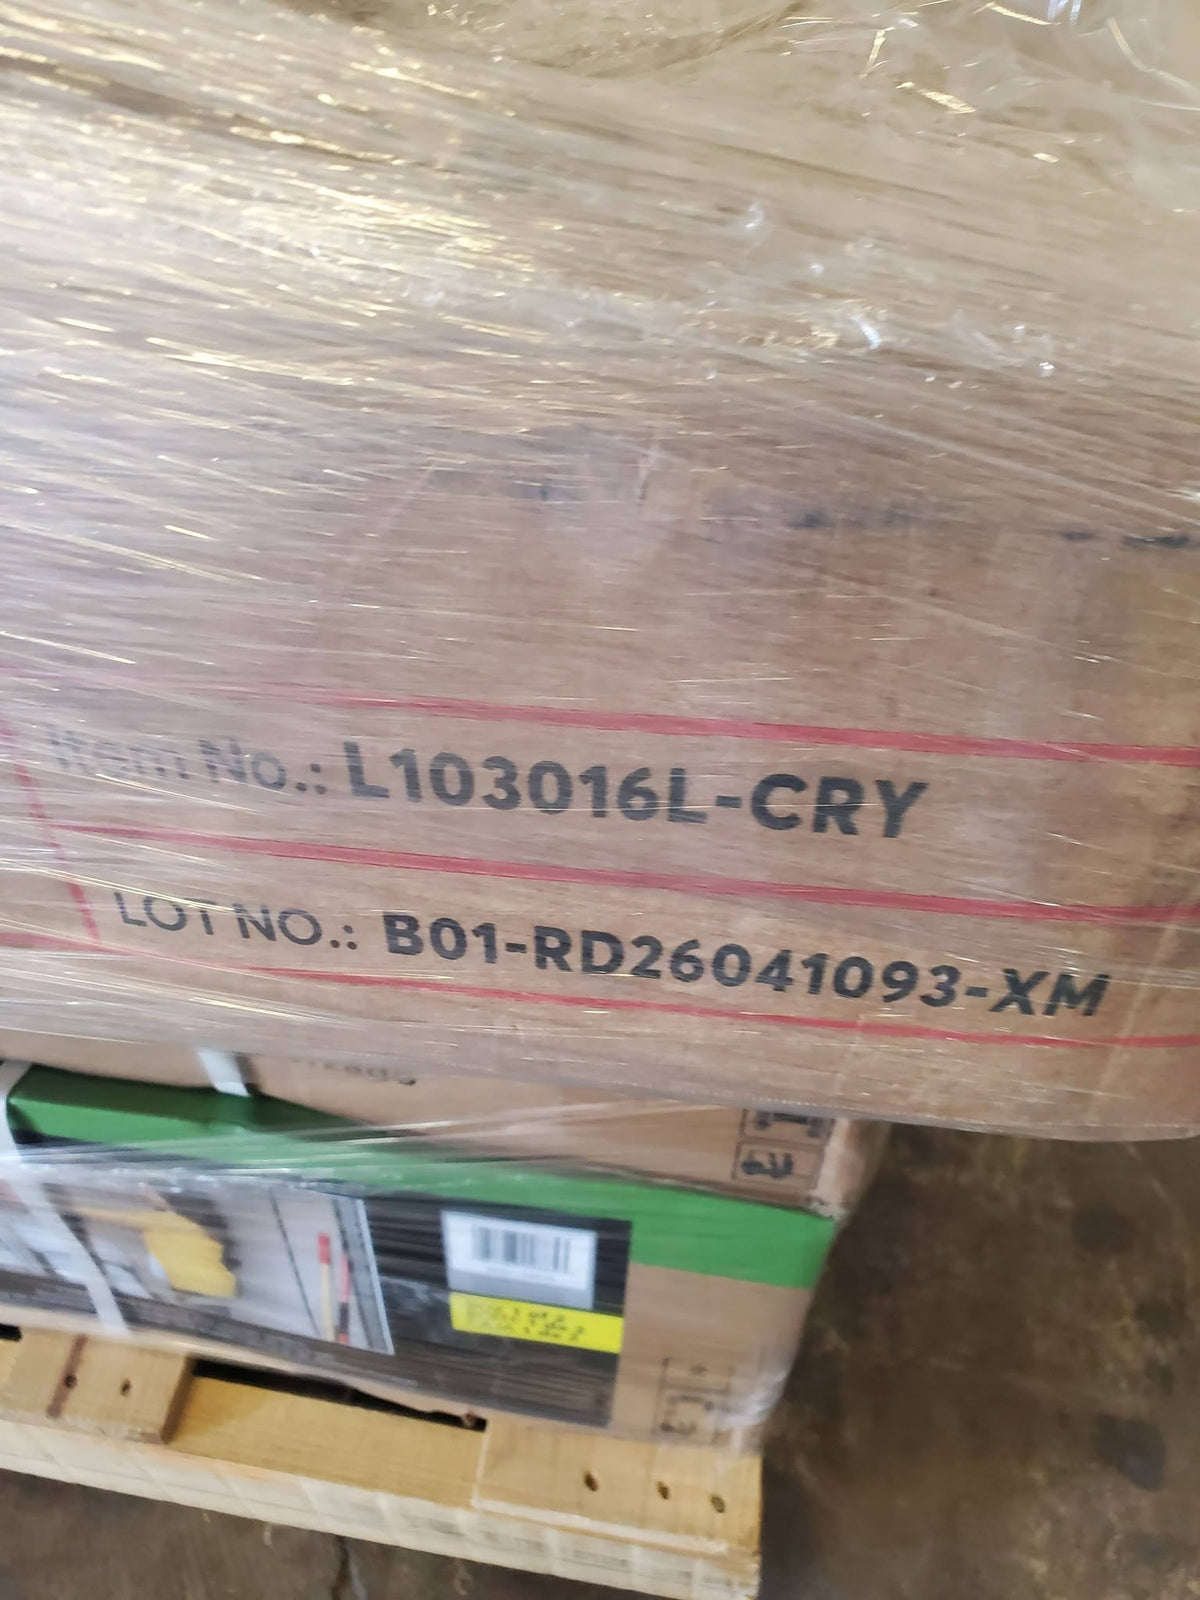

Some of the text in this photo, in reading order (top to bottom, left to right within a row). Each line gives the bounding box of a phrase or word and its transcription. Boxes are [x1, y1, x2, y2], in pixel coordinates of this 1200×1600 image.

[198, 738, 327, 795] No.:
[344, 741, 928, 838] L103016L-CRY
[114, 891, 1111, 1018] LOT NO.: B01-RD26041093-XM
